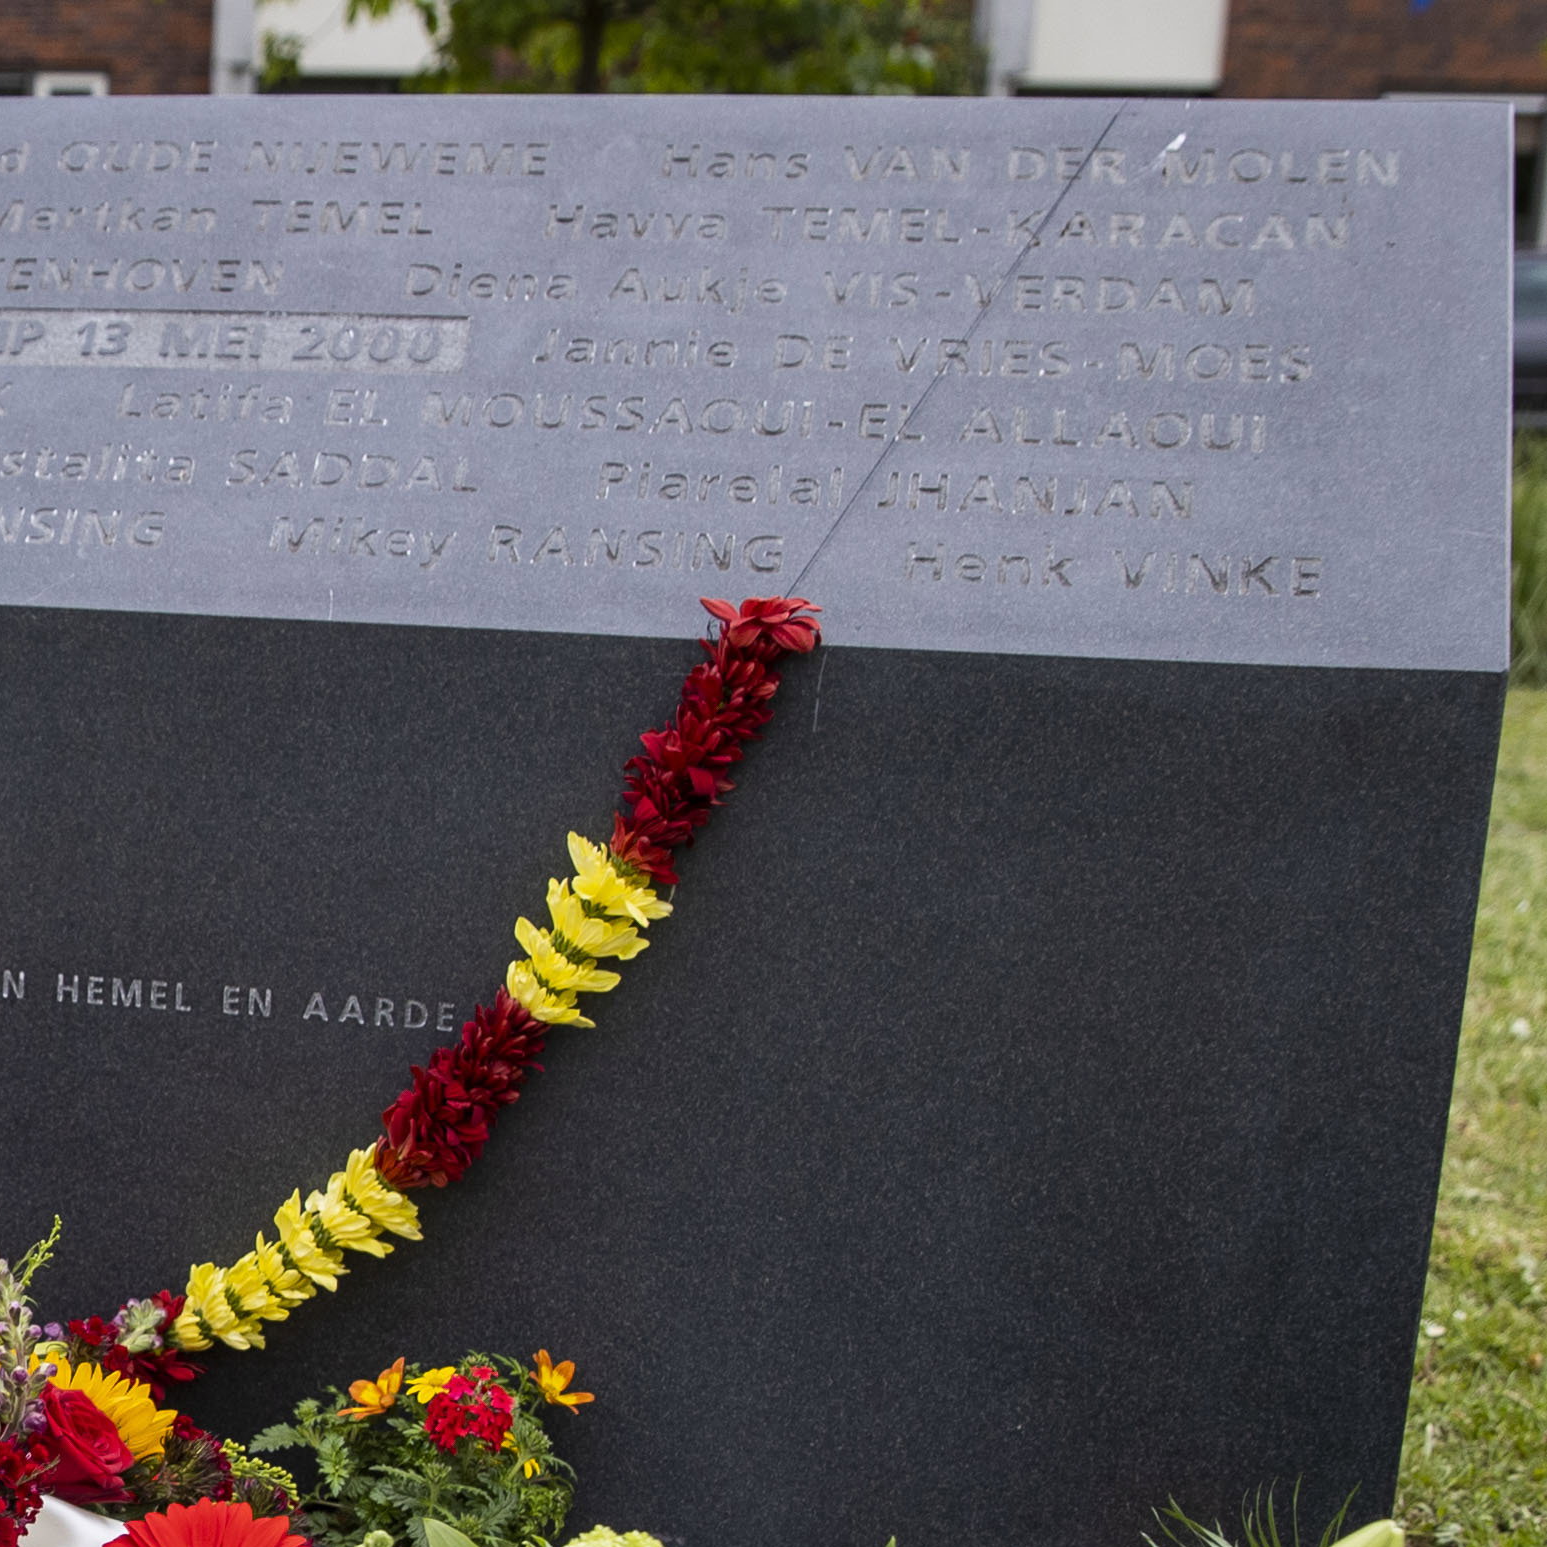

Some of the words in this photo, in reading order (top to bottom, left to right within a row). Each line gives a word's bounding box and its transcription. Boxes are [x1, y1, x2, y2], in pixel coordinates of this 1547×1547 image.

[58, 141, 218, 174] OUDE
[662, 143, 806, 179] Hans
[845, 144, 970, 180] VAN
[1006, 146, 1127, 185] DER
[1159, 149, 1401, 187] MOLEN
[251, 199, 433, 234] TEMEL
[542, 204, 729, 240] Havva
[761, 205, 1352, 249] TEMEL-KARACAN
[608, 266, 788, 315] Aukje
[824, 270, 1255, 316] VIS-VERDAM
[76, 321, 133, 359] 13
[157, 324, 268, 361] MEI
[291, 325, 442, 364] 2000
[533, 328, 738, 368] Jannie
[775, 332, 855, 371] DE
[887, 336, 1313, 383] VRIES-MOES
[117, 382, 294, 424] Latifa
[323, 387, 388, 427] EL
[957, 406, 1266, 453] ALLAOUI
[226, 451, 479, 493] SADDAL
[596, 462, 845, 505] Piarelal
[875, 471, 1195, 518] JHANJAN
[268, 515, 457, 569] Mikey
[486, 523, 786, 574] RANSING
[905, 541, 1076, 588] Henk
[1113, 550, 1323, 598] VINKE
[56, 972, 192, 1012] HEMEL
[222, 985, 272, 1018] EN
[303, 991, 455, 1032] AARDE
